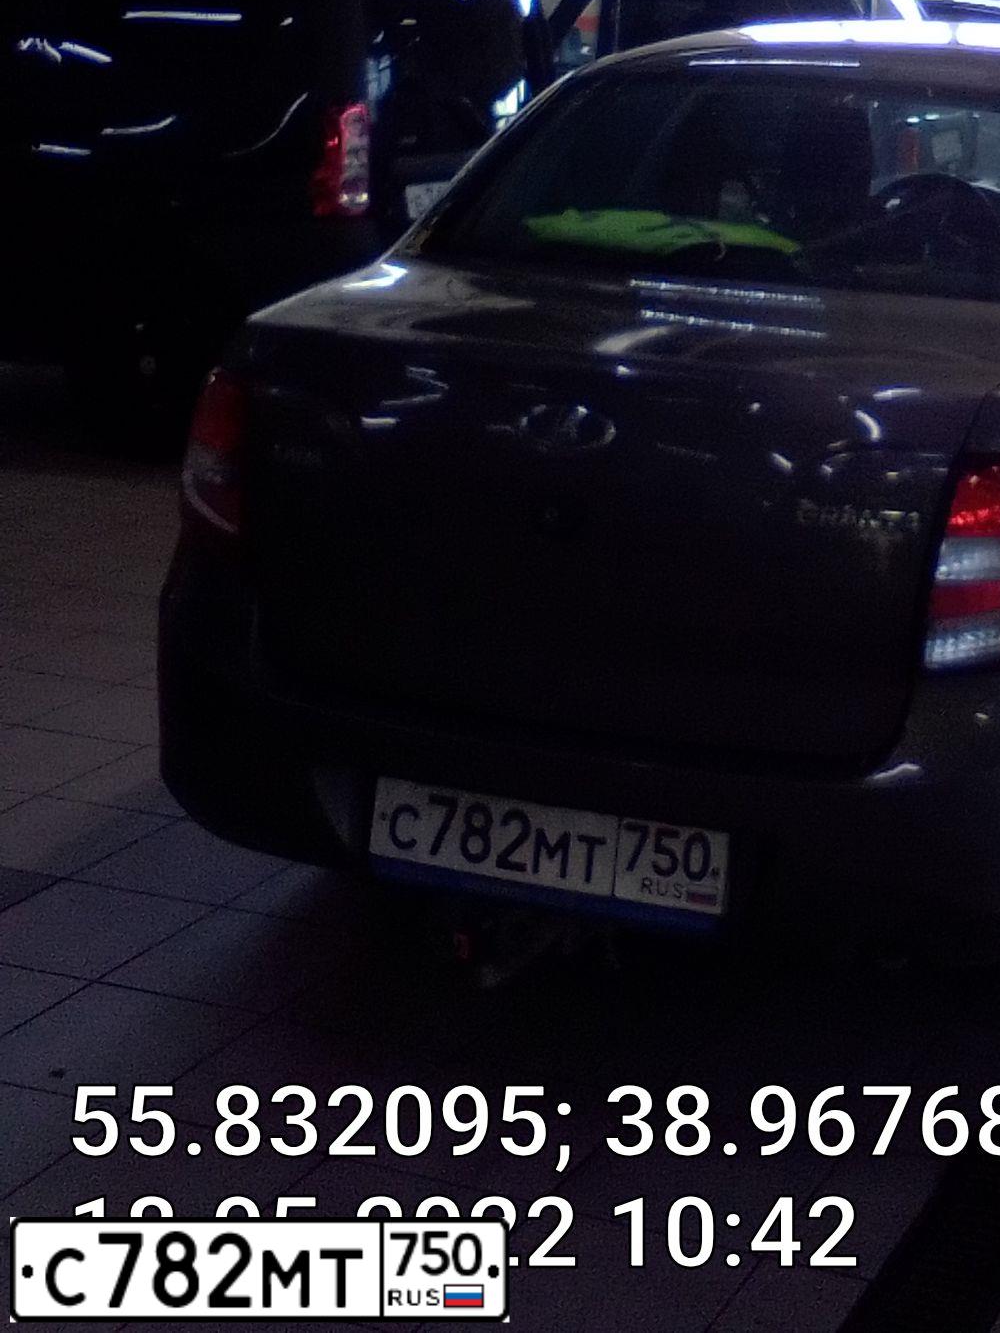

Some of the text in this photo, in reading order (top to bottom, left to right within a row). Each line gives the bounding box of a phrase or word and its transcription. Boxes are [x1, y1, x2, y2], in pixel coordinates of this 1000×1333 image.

[388, 793, 712, 884] C782MT 750
[640, 876, 684, 900] RUS
